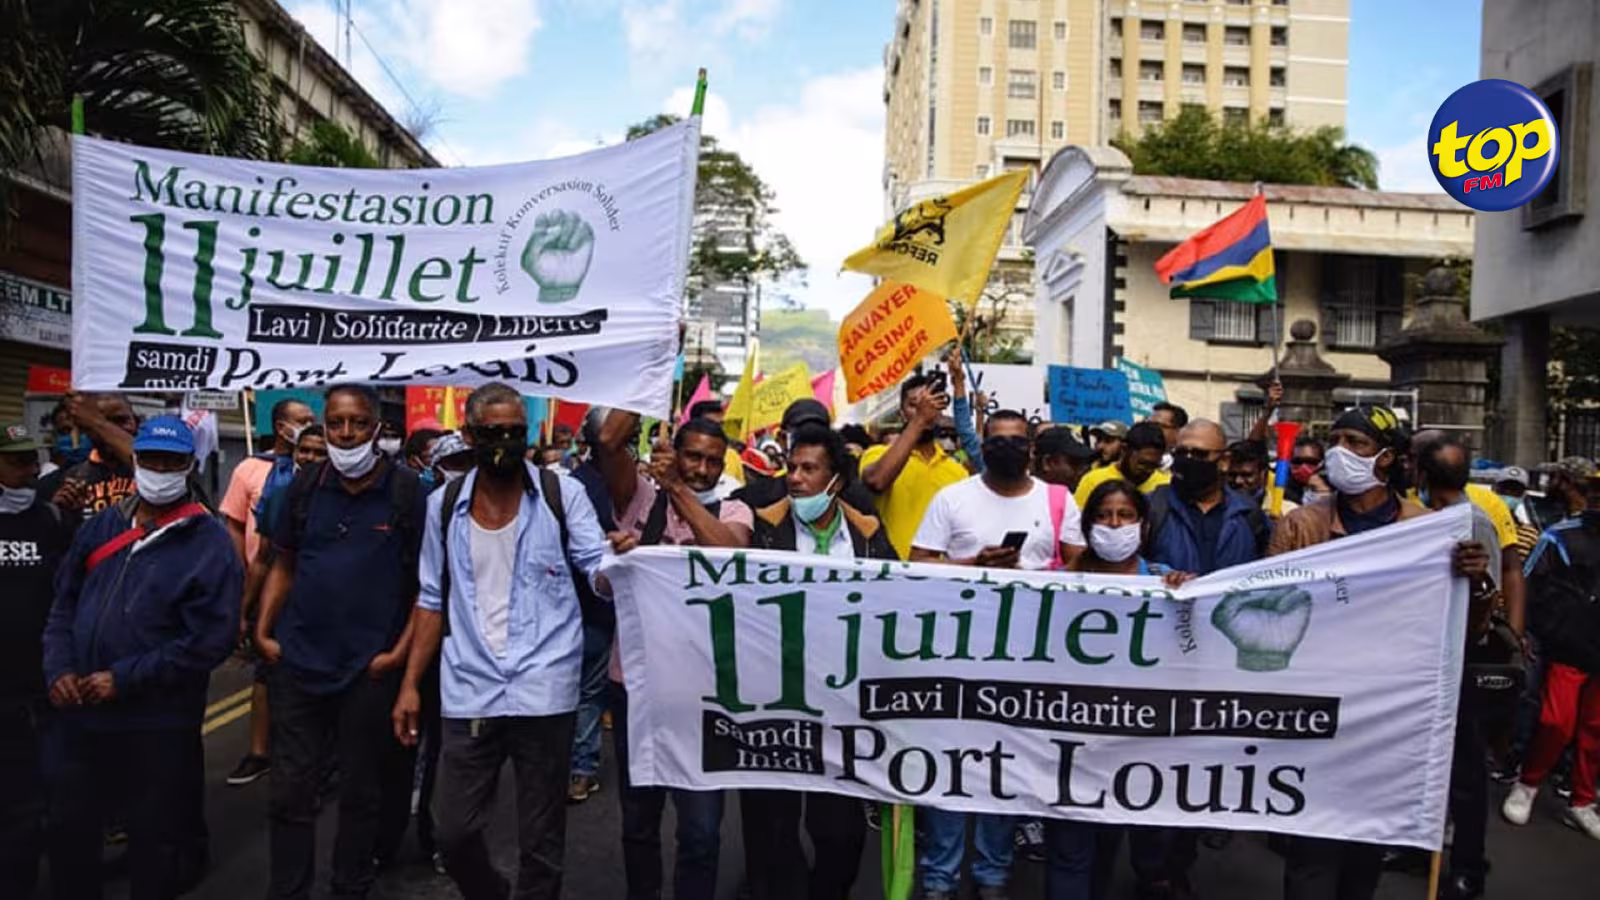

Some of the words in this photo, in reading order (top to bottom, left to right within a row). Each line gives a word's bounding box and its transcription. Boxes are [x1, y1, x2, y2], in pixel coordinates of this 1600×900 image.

[130, 160, 494, 226] Manifestasion
[506, 180, 593, 230] Konversasion
[594, 183, 621, 232] Solider
[130, 212, 224, 339] 11
[225, 227, 486, 310] juillet
[252, 308, 310, 338] Lavi
[332, 312, 467, 340] Solidarite
[841, 284, 917, 363] RAVAYER
[854, 315, 914, 377] CASINO
[136, 347, 211, 372] samdi
[144, 374, 200, 388] midi
[857, 329, 929, 399] ENKOLER
[685, 590, 823, 717] 11
[826, 588, 1165, 689] juillet
[714, 719, 814, 750] samdi
[865, 684, 944, 713] Lavi
[976, 686, 1157, 729] Solidarite
[1189, 700, 1331, 735] Liberte
[832, 724, 1016, 800] Port
[1047, 738, 1308, 816] Louis
